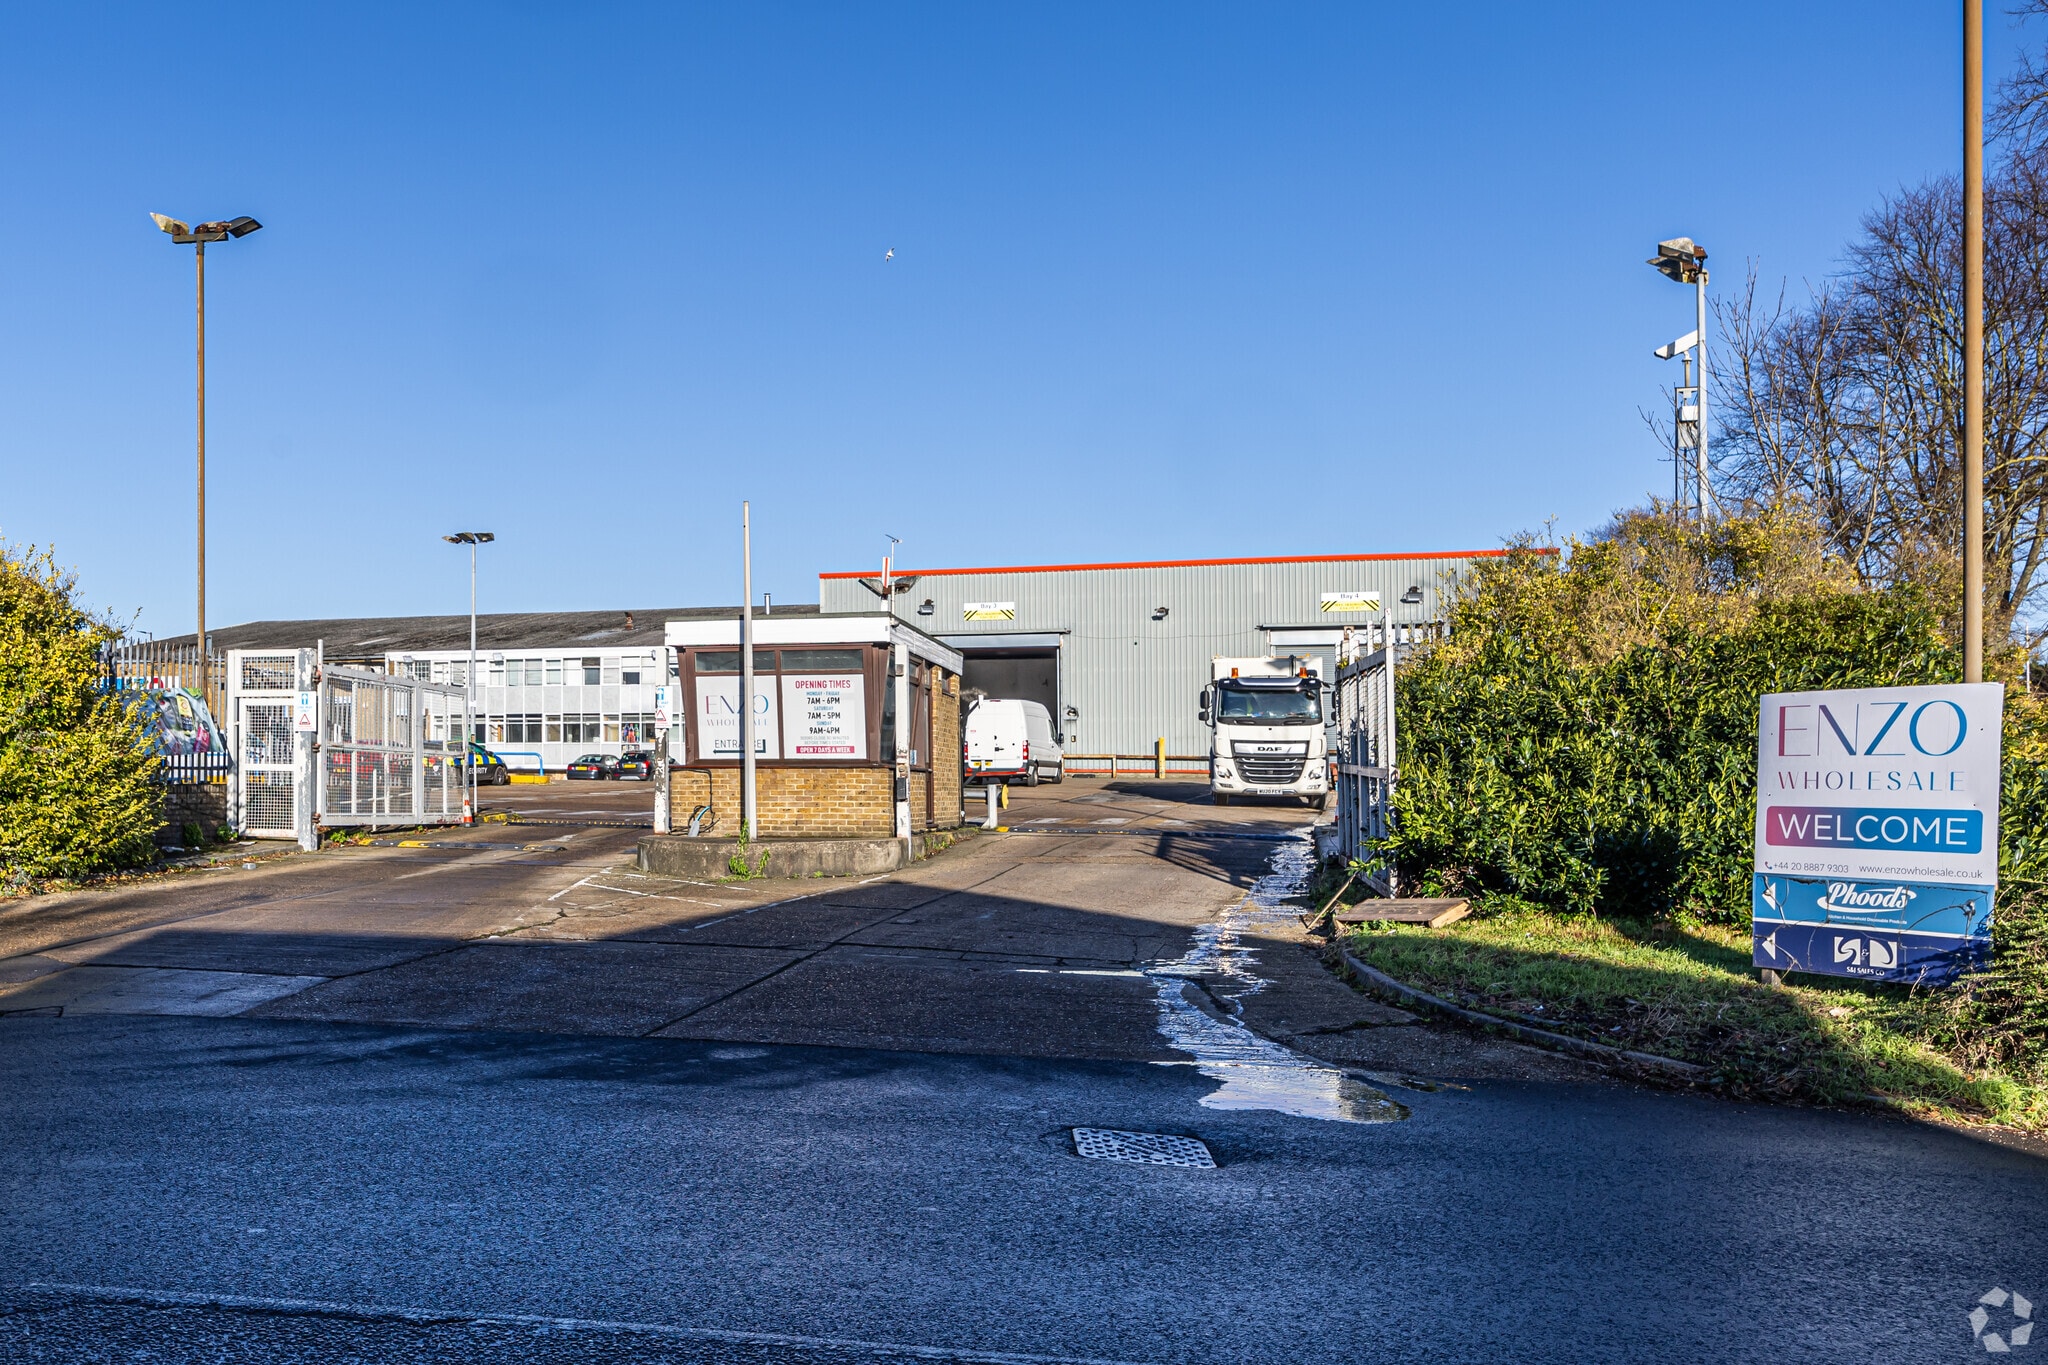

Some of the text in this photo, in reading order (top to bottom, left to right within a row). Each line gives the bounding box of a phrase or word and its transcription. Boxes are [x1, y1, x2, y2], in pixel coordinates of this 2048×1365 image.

[795, 680, 851, 689] OPENING TIMES
[1778, 700, 1968, 757] ENZO
[715, 739, 762, 748] ENTRAE
[1778, 771, 1967, 792] WHOLESALE
[1778, 814, 1968, 846] WELCOME
[1827, 864, 1849, 873] 9303
[1859, 865, 1983, 879] www.enzowholesale.co.uk
